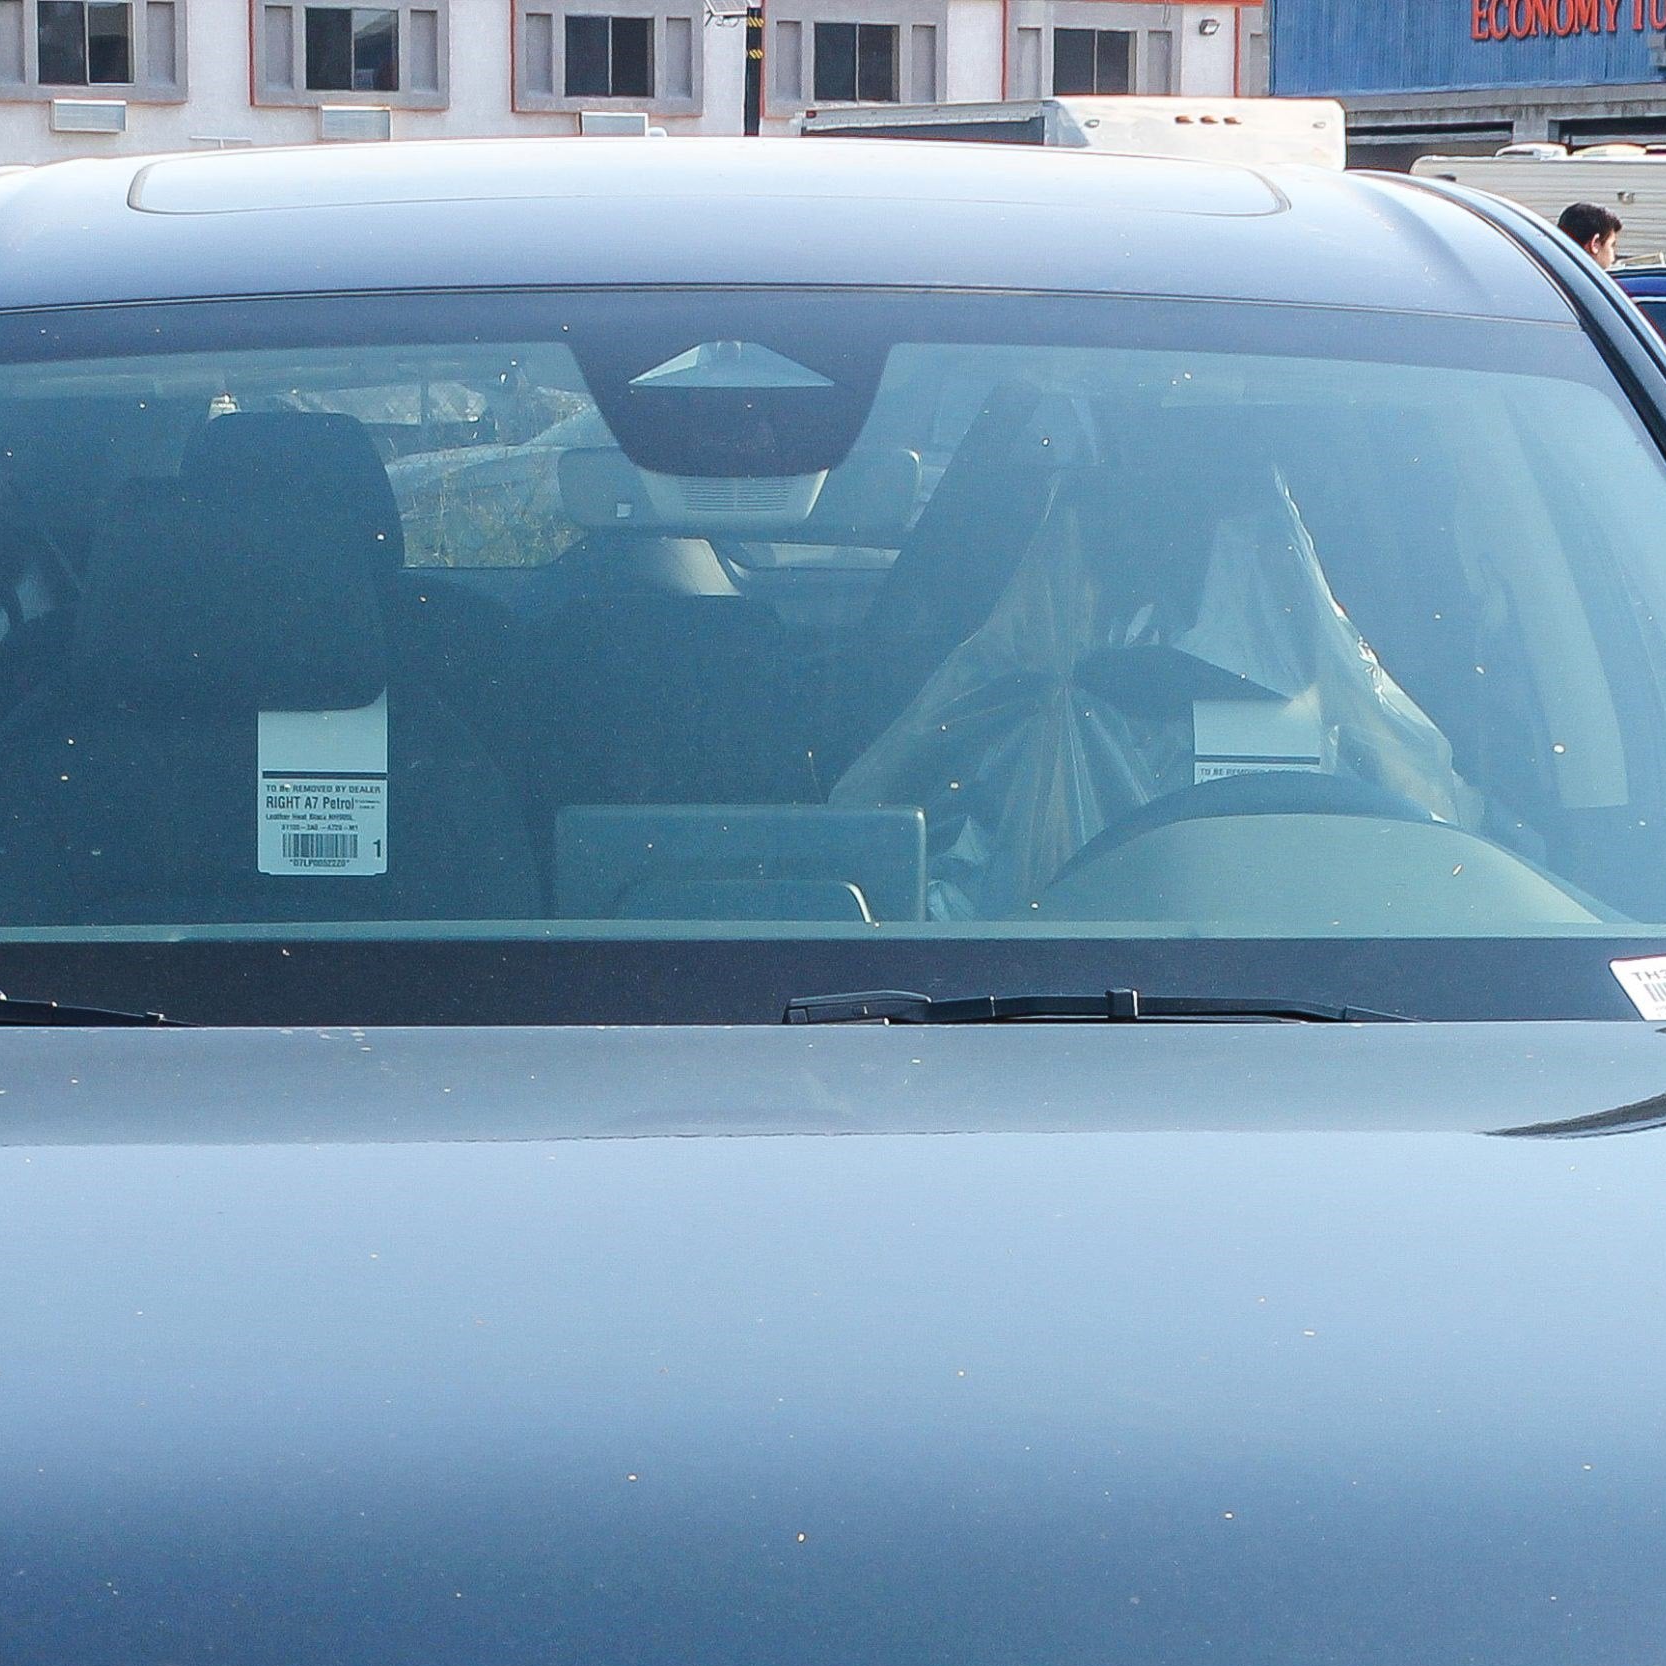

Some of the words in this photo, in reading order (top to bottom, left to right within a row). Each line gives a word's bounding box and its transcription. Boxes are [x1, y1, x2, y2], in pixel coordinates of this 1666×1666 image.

[1471, 0, 1620, 40] ECONOMY
[266, 784, 277, 792] TO
[293, 784, 333, 793] REMOVED
[335, 785, 347, 793] BY
[349, 785, 381, 794] DEALER
[266, 796, 301, 810] RIGHT
[304, 797, 319, 810] A7
[373, 839, 382, 858] 1
